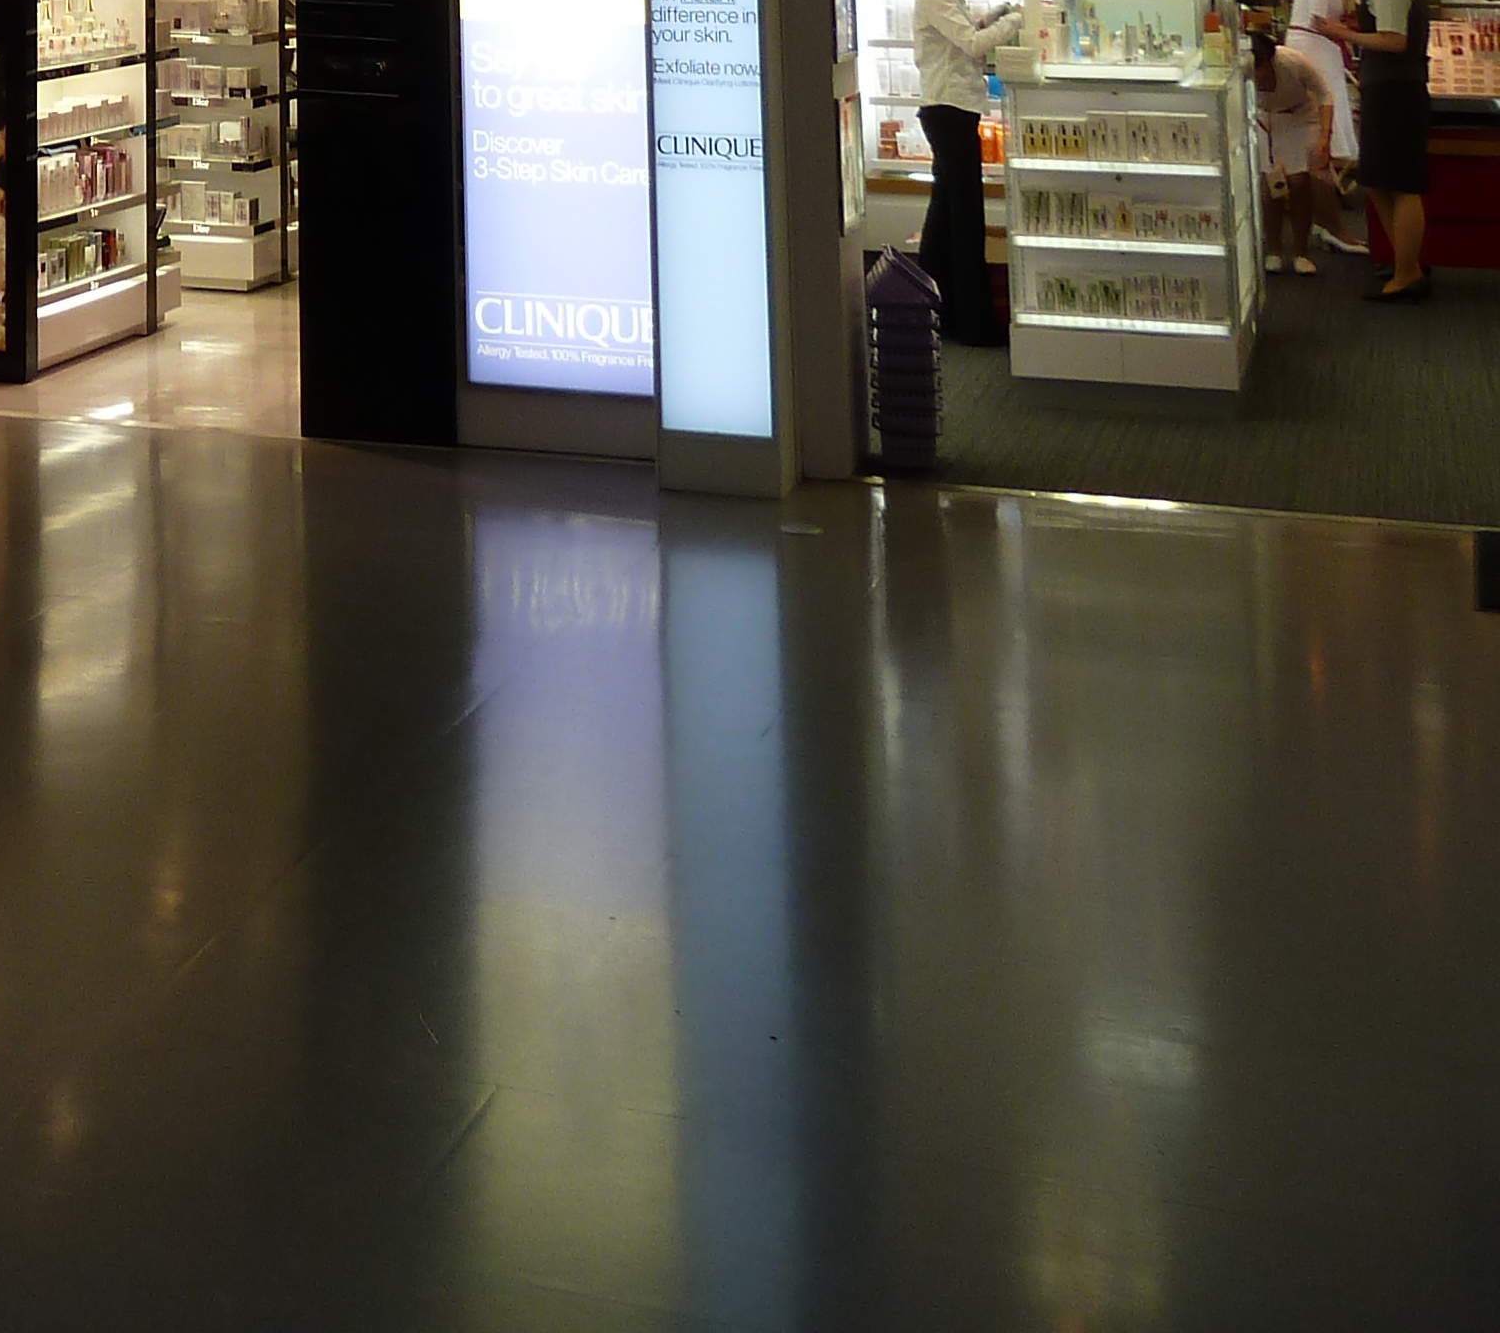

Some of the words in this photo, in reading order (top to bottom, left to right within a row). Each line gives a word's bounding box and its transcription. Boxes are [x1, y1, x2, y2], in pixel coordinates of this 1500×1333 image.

[652, 6, 740, 24] difference
[742, 8, 757, 24] in
[653, 29, 690, 46] your
[694, 26, 733, 43] skin.
[654, 58, 721, 76] Exfoliate
[471, 78, 503, 109] to
[506, 82, 586, 118] great
[473, 129, 564, 156] Discover
[657, 134, 763, 161] CLINIQUE
[474, 156, 547, 186] 3-Step
[550, 158, 597, 184] Skin
[601, 160, 650, 186] Care
[477, 343, 511, 360] Allergy
[514, 346, 550, 361] Tested.
[552, 349, 580, 363] 100%
[581, 351, 635, 367] Fragrance
